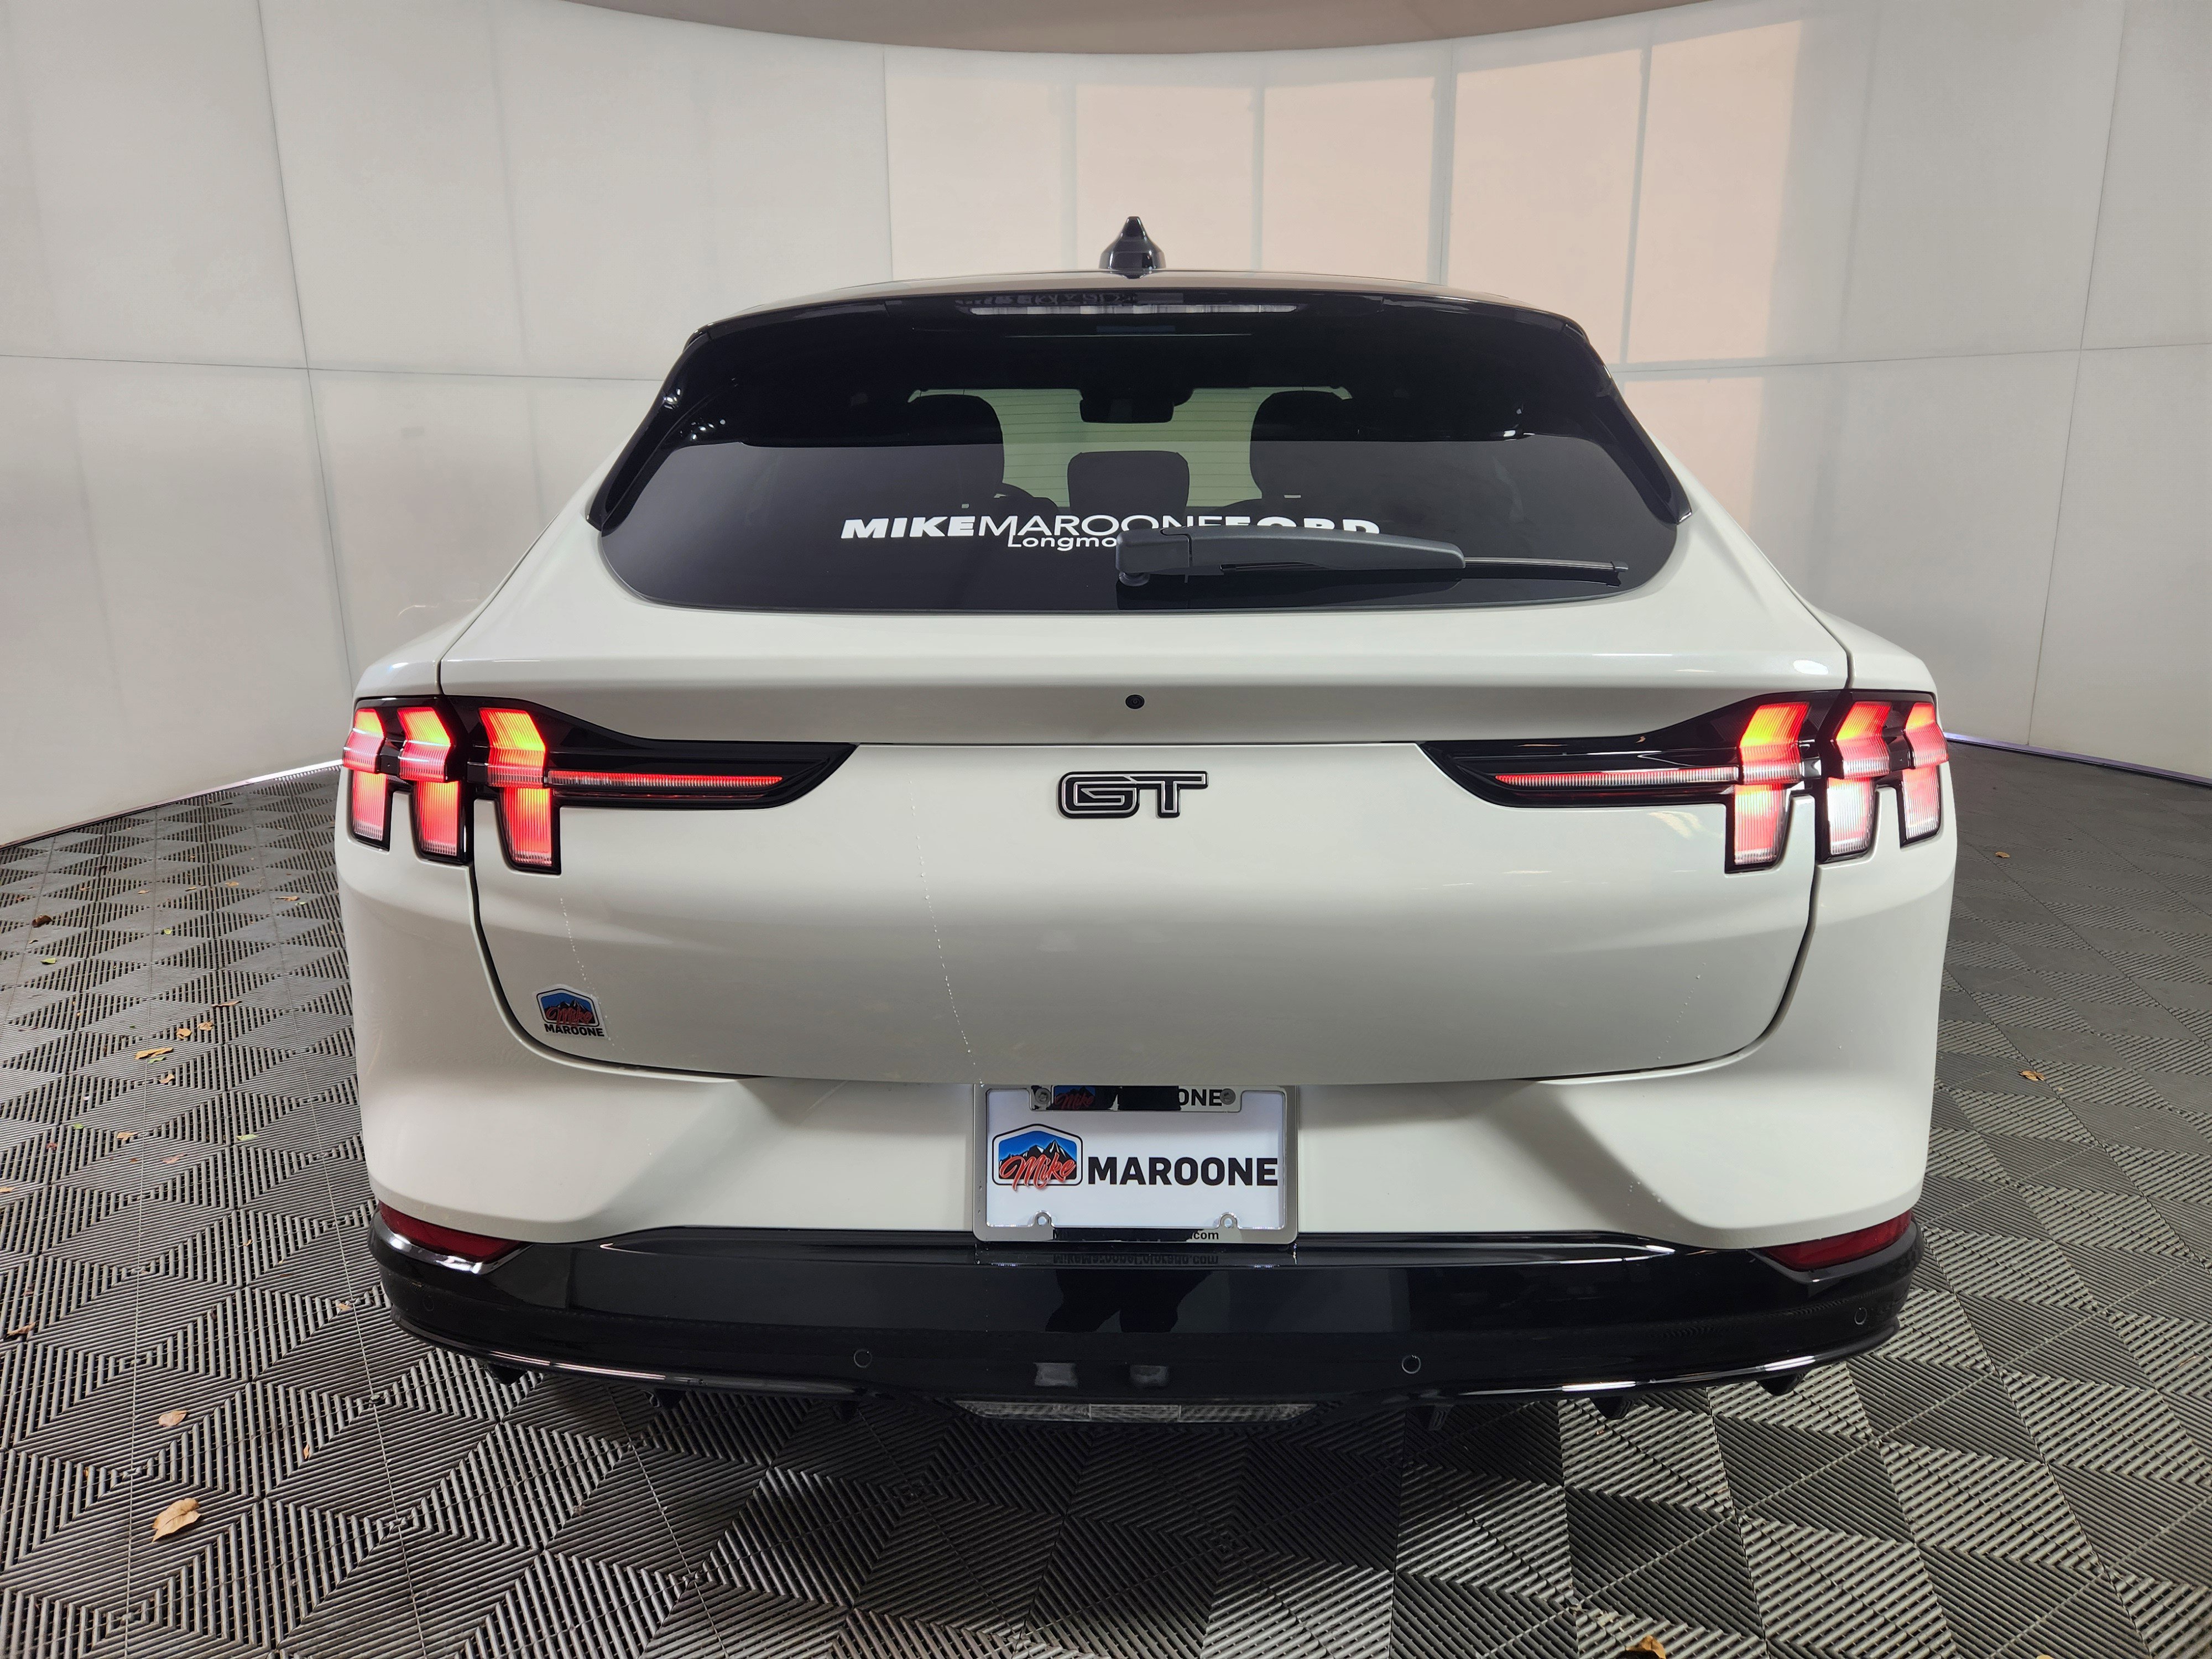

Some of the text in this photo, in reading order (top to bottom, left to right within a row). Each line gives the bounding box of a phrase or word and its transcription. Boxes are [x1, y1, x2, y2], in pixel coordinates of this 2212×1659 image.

[1008, 534, 1117, 551] Longmo
[1058, 771, 1208, 818] GT
[546, 1007, 593, 1027] Mike
[544, 1023, 604, 1037] MAROONE
[1000, 1152, 1278, 1191] Mike MAROONE
